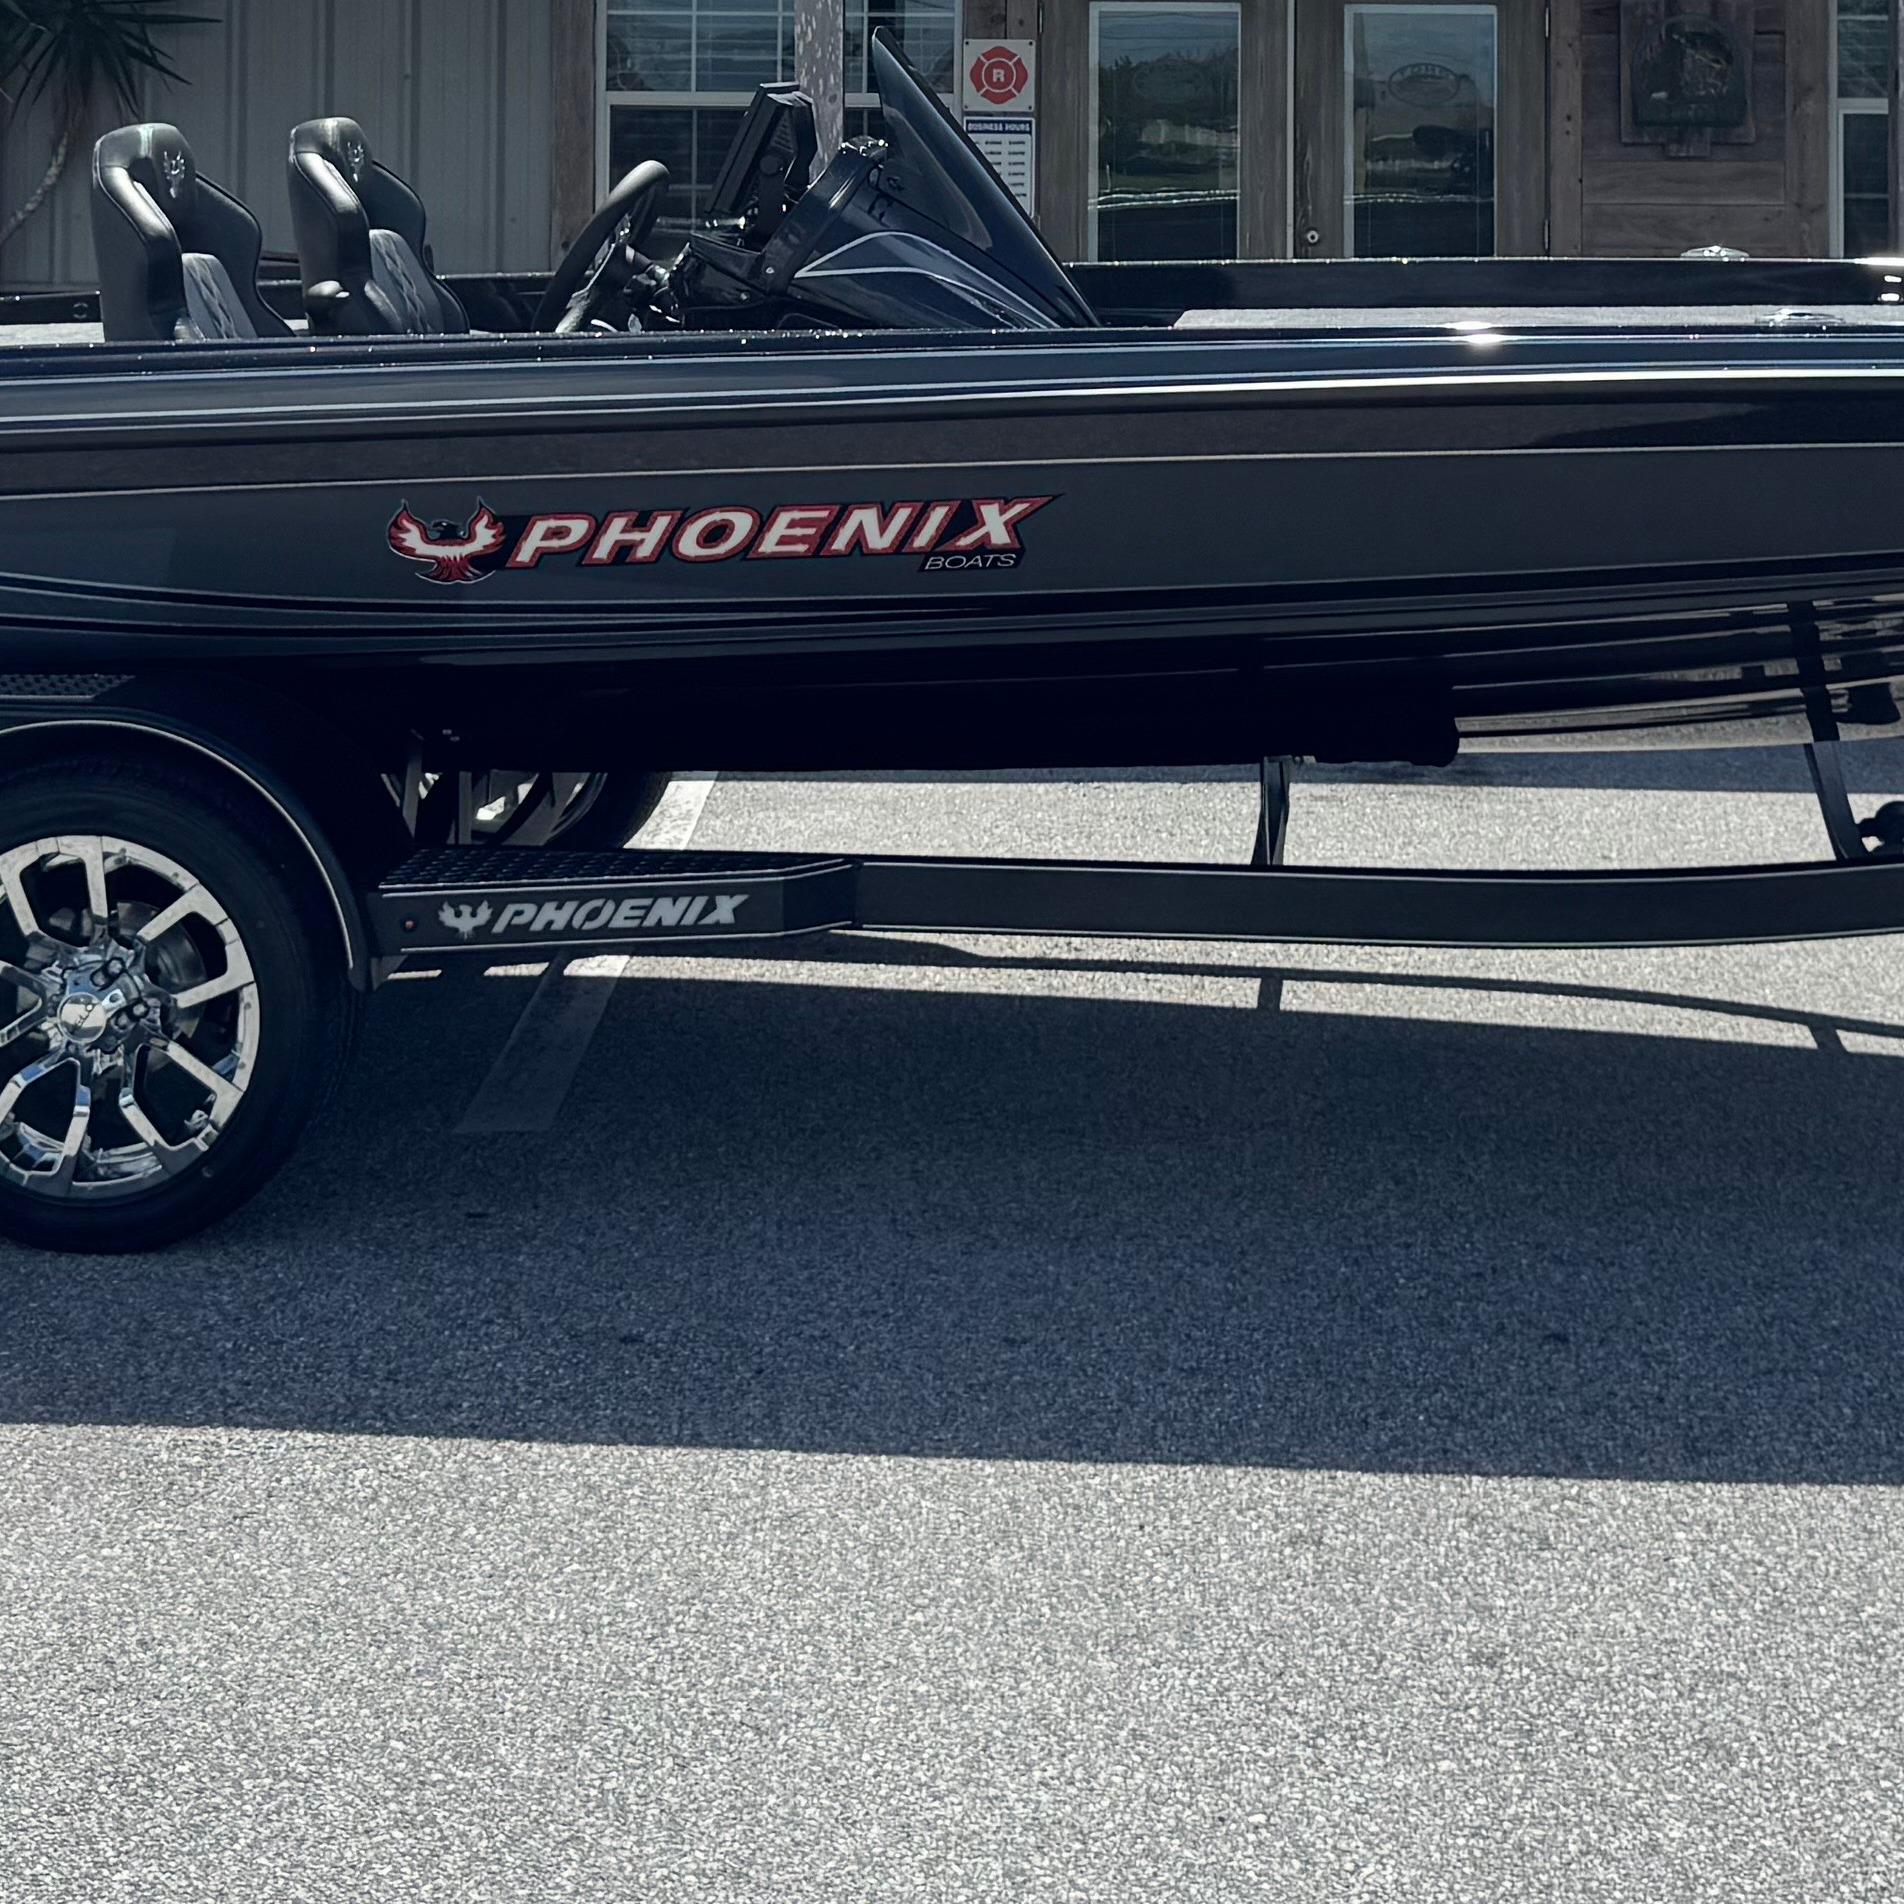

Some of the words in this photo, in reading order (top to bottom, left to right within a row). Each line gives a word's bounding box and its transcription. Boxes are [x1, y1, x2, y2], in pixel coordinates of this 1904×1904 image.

[505, 497, 1052, 568] PHOENIX
[924, 553, 1017, 571] BOATS
[491, 894, 749, 933] PHOENIX
